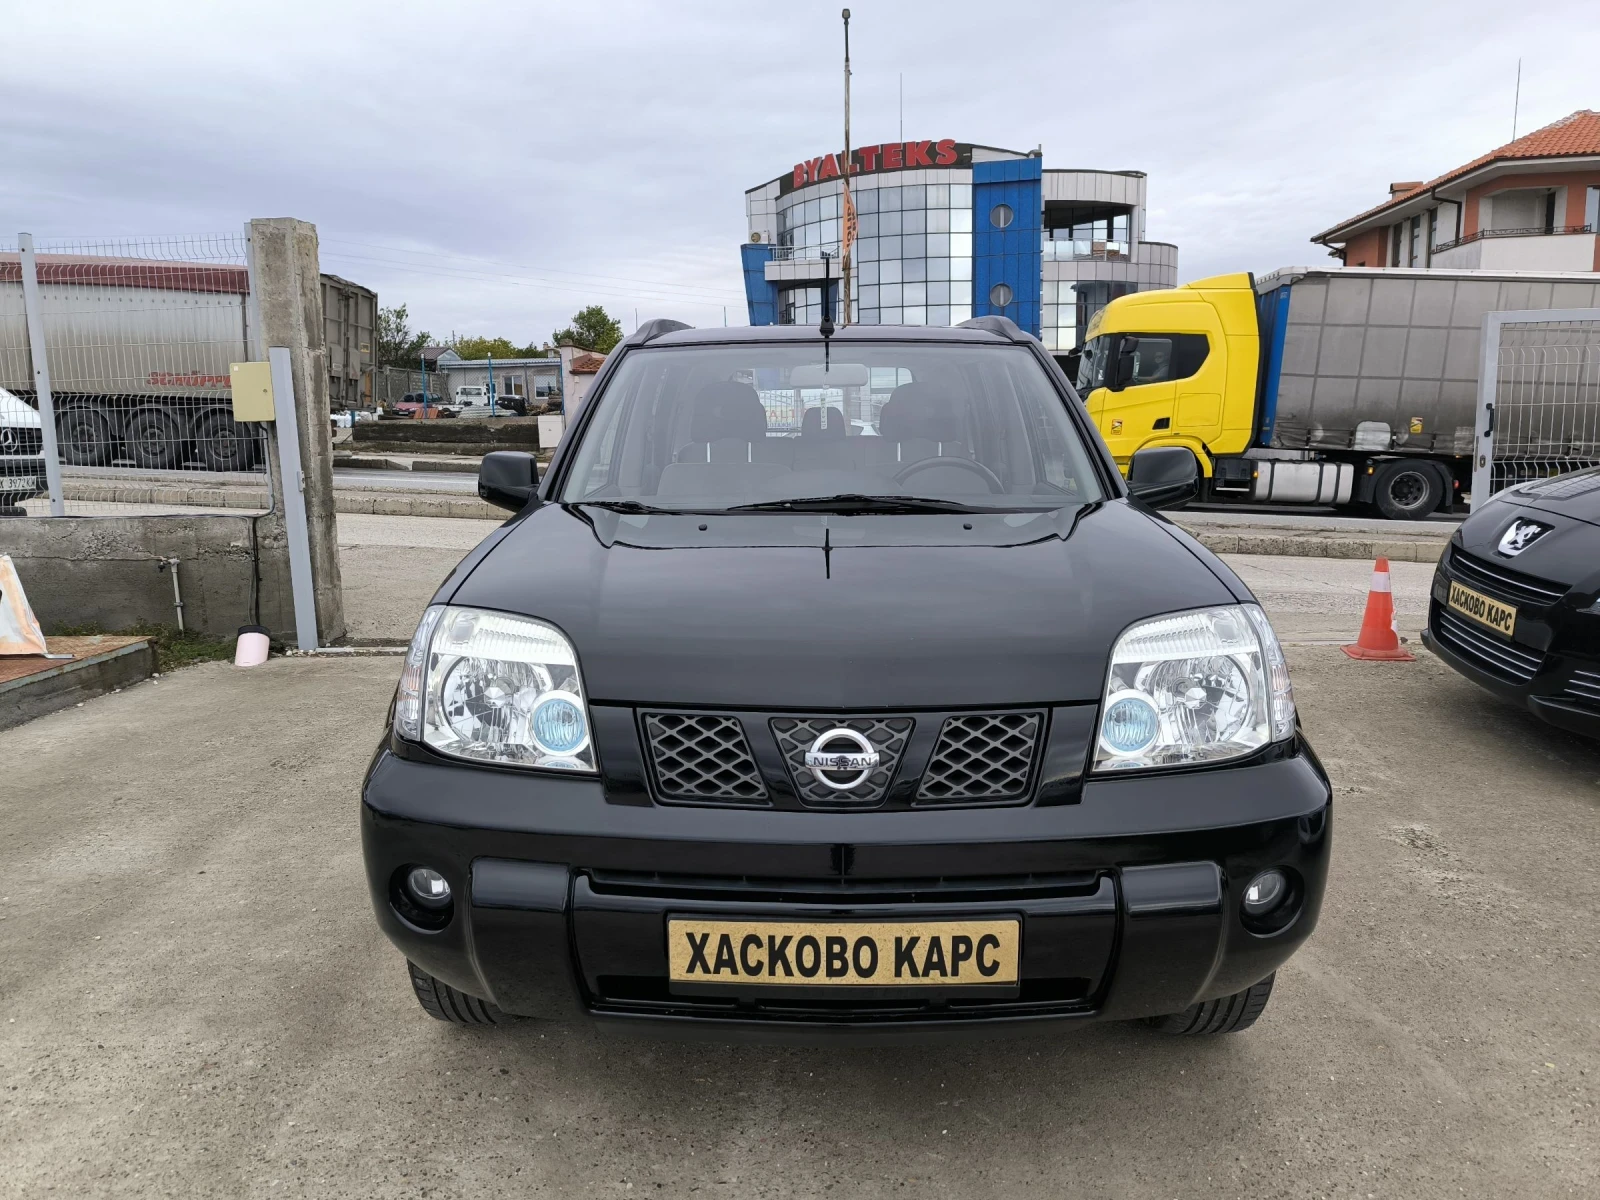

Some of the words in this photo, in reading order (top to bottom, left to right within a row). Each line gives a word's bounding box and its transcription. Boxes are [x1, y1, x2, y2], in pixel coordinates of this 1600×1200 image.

[794, 139, 958, 188] BYALTEKS
[1450, 585, 1486, 618] ХАСКОВО
[1486, 602, 1513, 631] КАРС
[813, 757, 872, 767] NISSAN
[685, 932, 879, 979] ХАСКОВО
[894, 933, 1001, 978] КАРС
